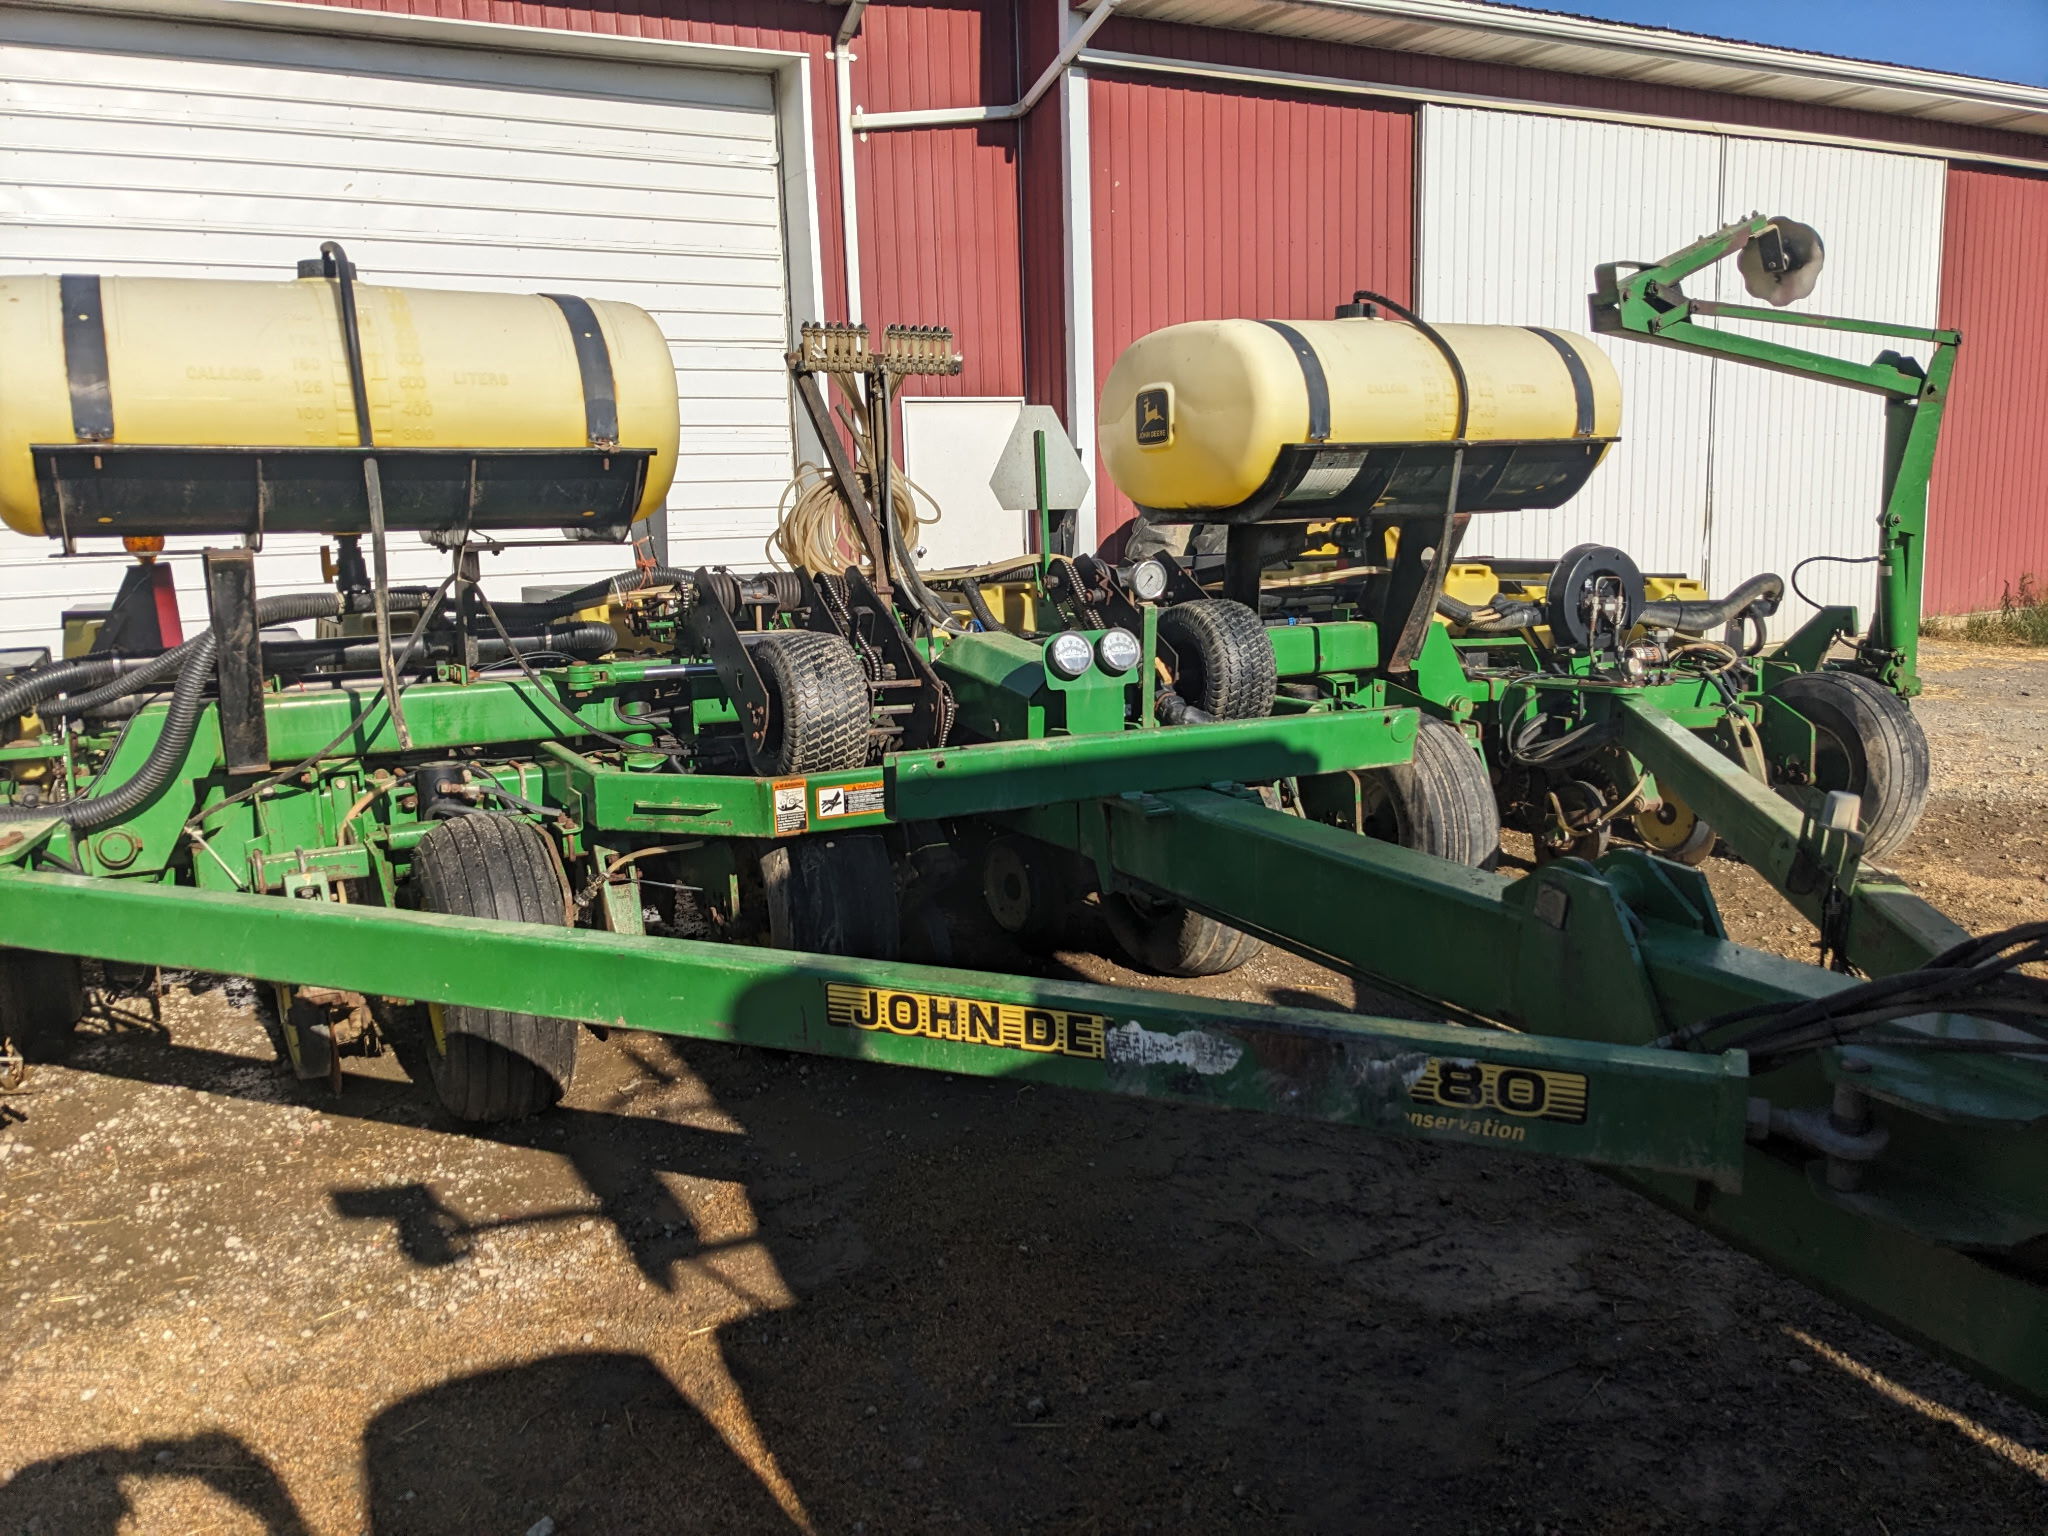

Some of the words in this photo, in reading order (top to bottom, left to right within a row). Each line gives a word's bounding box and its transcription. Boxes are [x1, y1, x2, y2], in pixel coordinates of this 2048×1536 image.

[453, 371, 509, 386] LITERS
[853, 989, 1002, 1044] JOHN
[1022, 1008, 1108, 1056] DE
[1406, 1111, 1526, 1140] nservation
